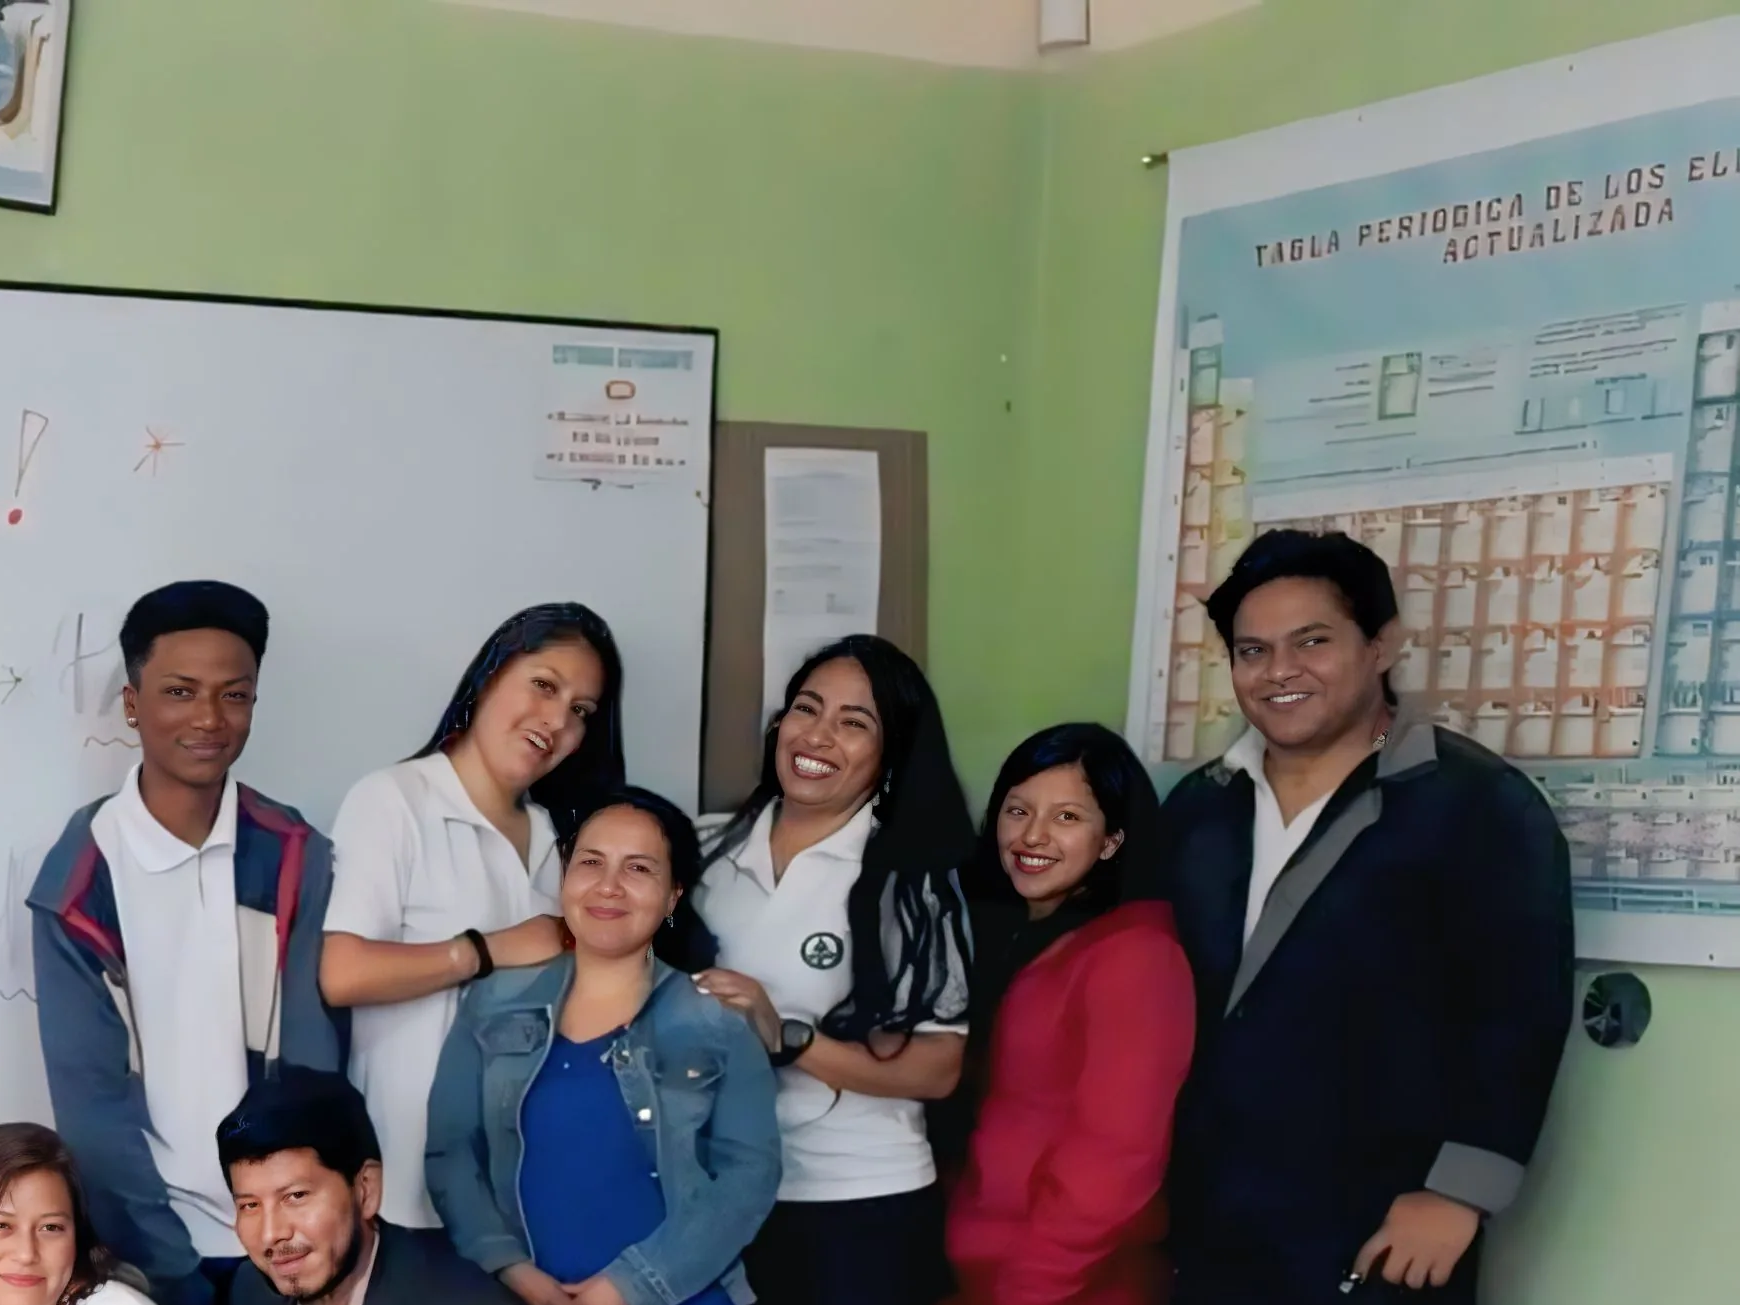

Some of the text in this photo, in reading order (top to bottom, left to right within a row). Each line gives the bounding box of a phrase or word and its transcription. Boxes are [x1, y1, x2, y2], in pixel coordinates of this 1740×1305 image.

[1545, 181, 1583, 211] DE
[1604, 163, 1666, 200] LOS
[1687, 147, 1740, 182] EL
[1442, 198, 1673, 263] ACTUALIZADA
